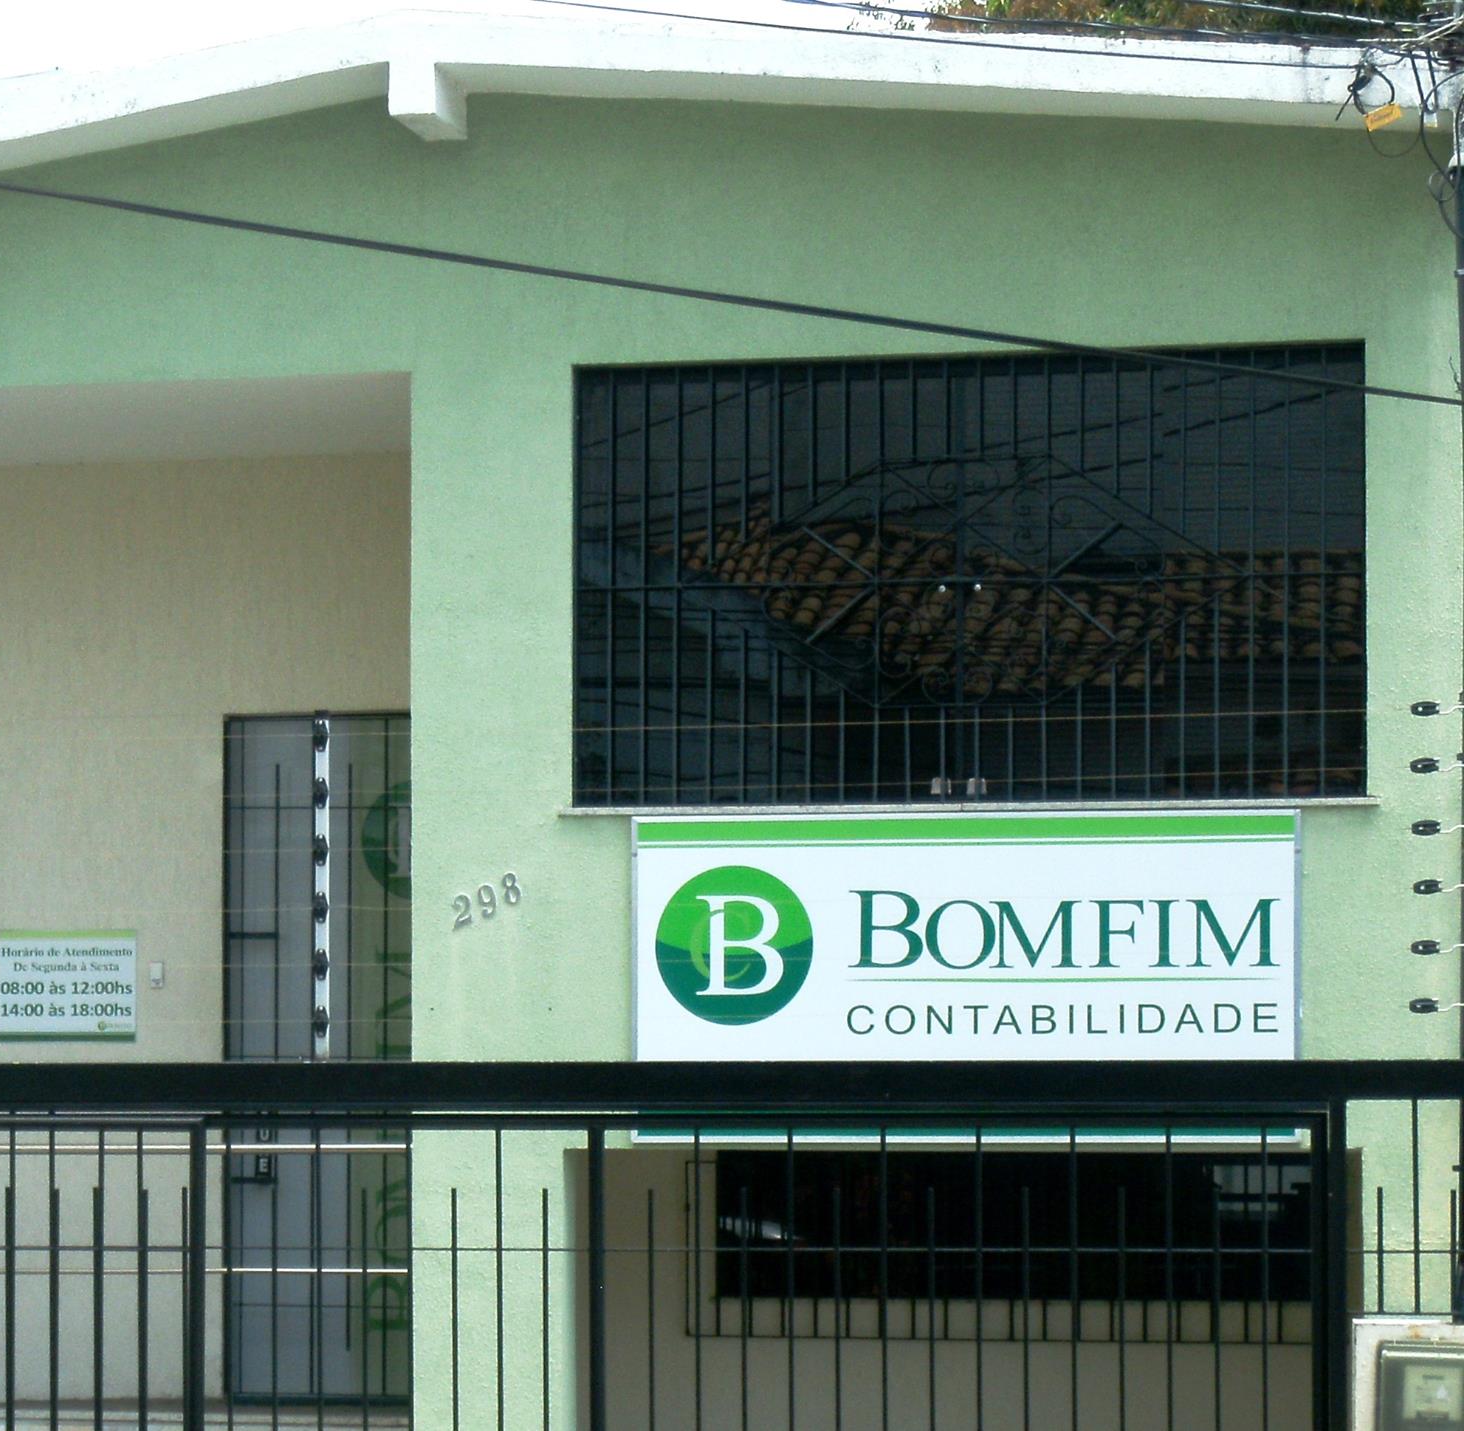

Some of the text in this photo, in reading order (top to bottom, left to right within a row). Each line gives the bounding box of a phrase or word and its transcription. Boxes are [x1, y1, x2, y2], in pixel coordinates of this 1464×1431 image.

[451, 871, 521, 931] 298
[848, 889, 1281, 970] BOMFIM
[47, 947, 61, 957] de
[63, 947, 133, 957] Atendimento
[13, 962, 27, 971] De
[31, 962, 77, 974] Segunda
[90, 962, 120, 971] Sexta
[0, 981, 133, 995] 08:00 às 12:00hs
[0, 1002, 132, 1017] 14:00 às 18:00hs
[846, 1002, 1280, 1035] CONTABILIDADE
